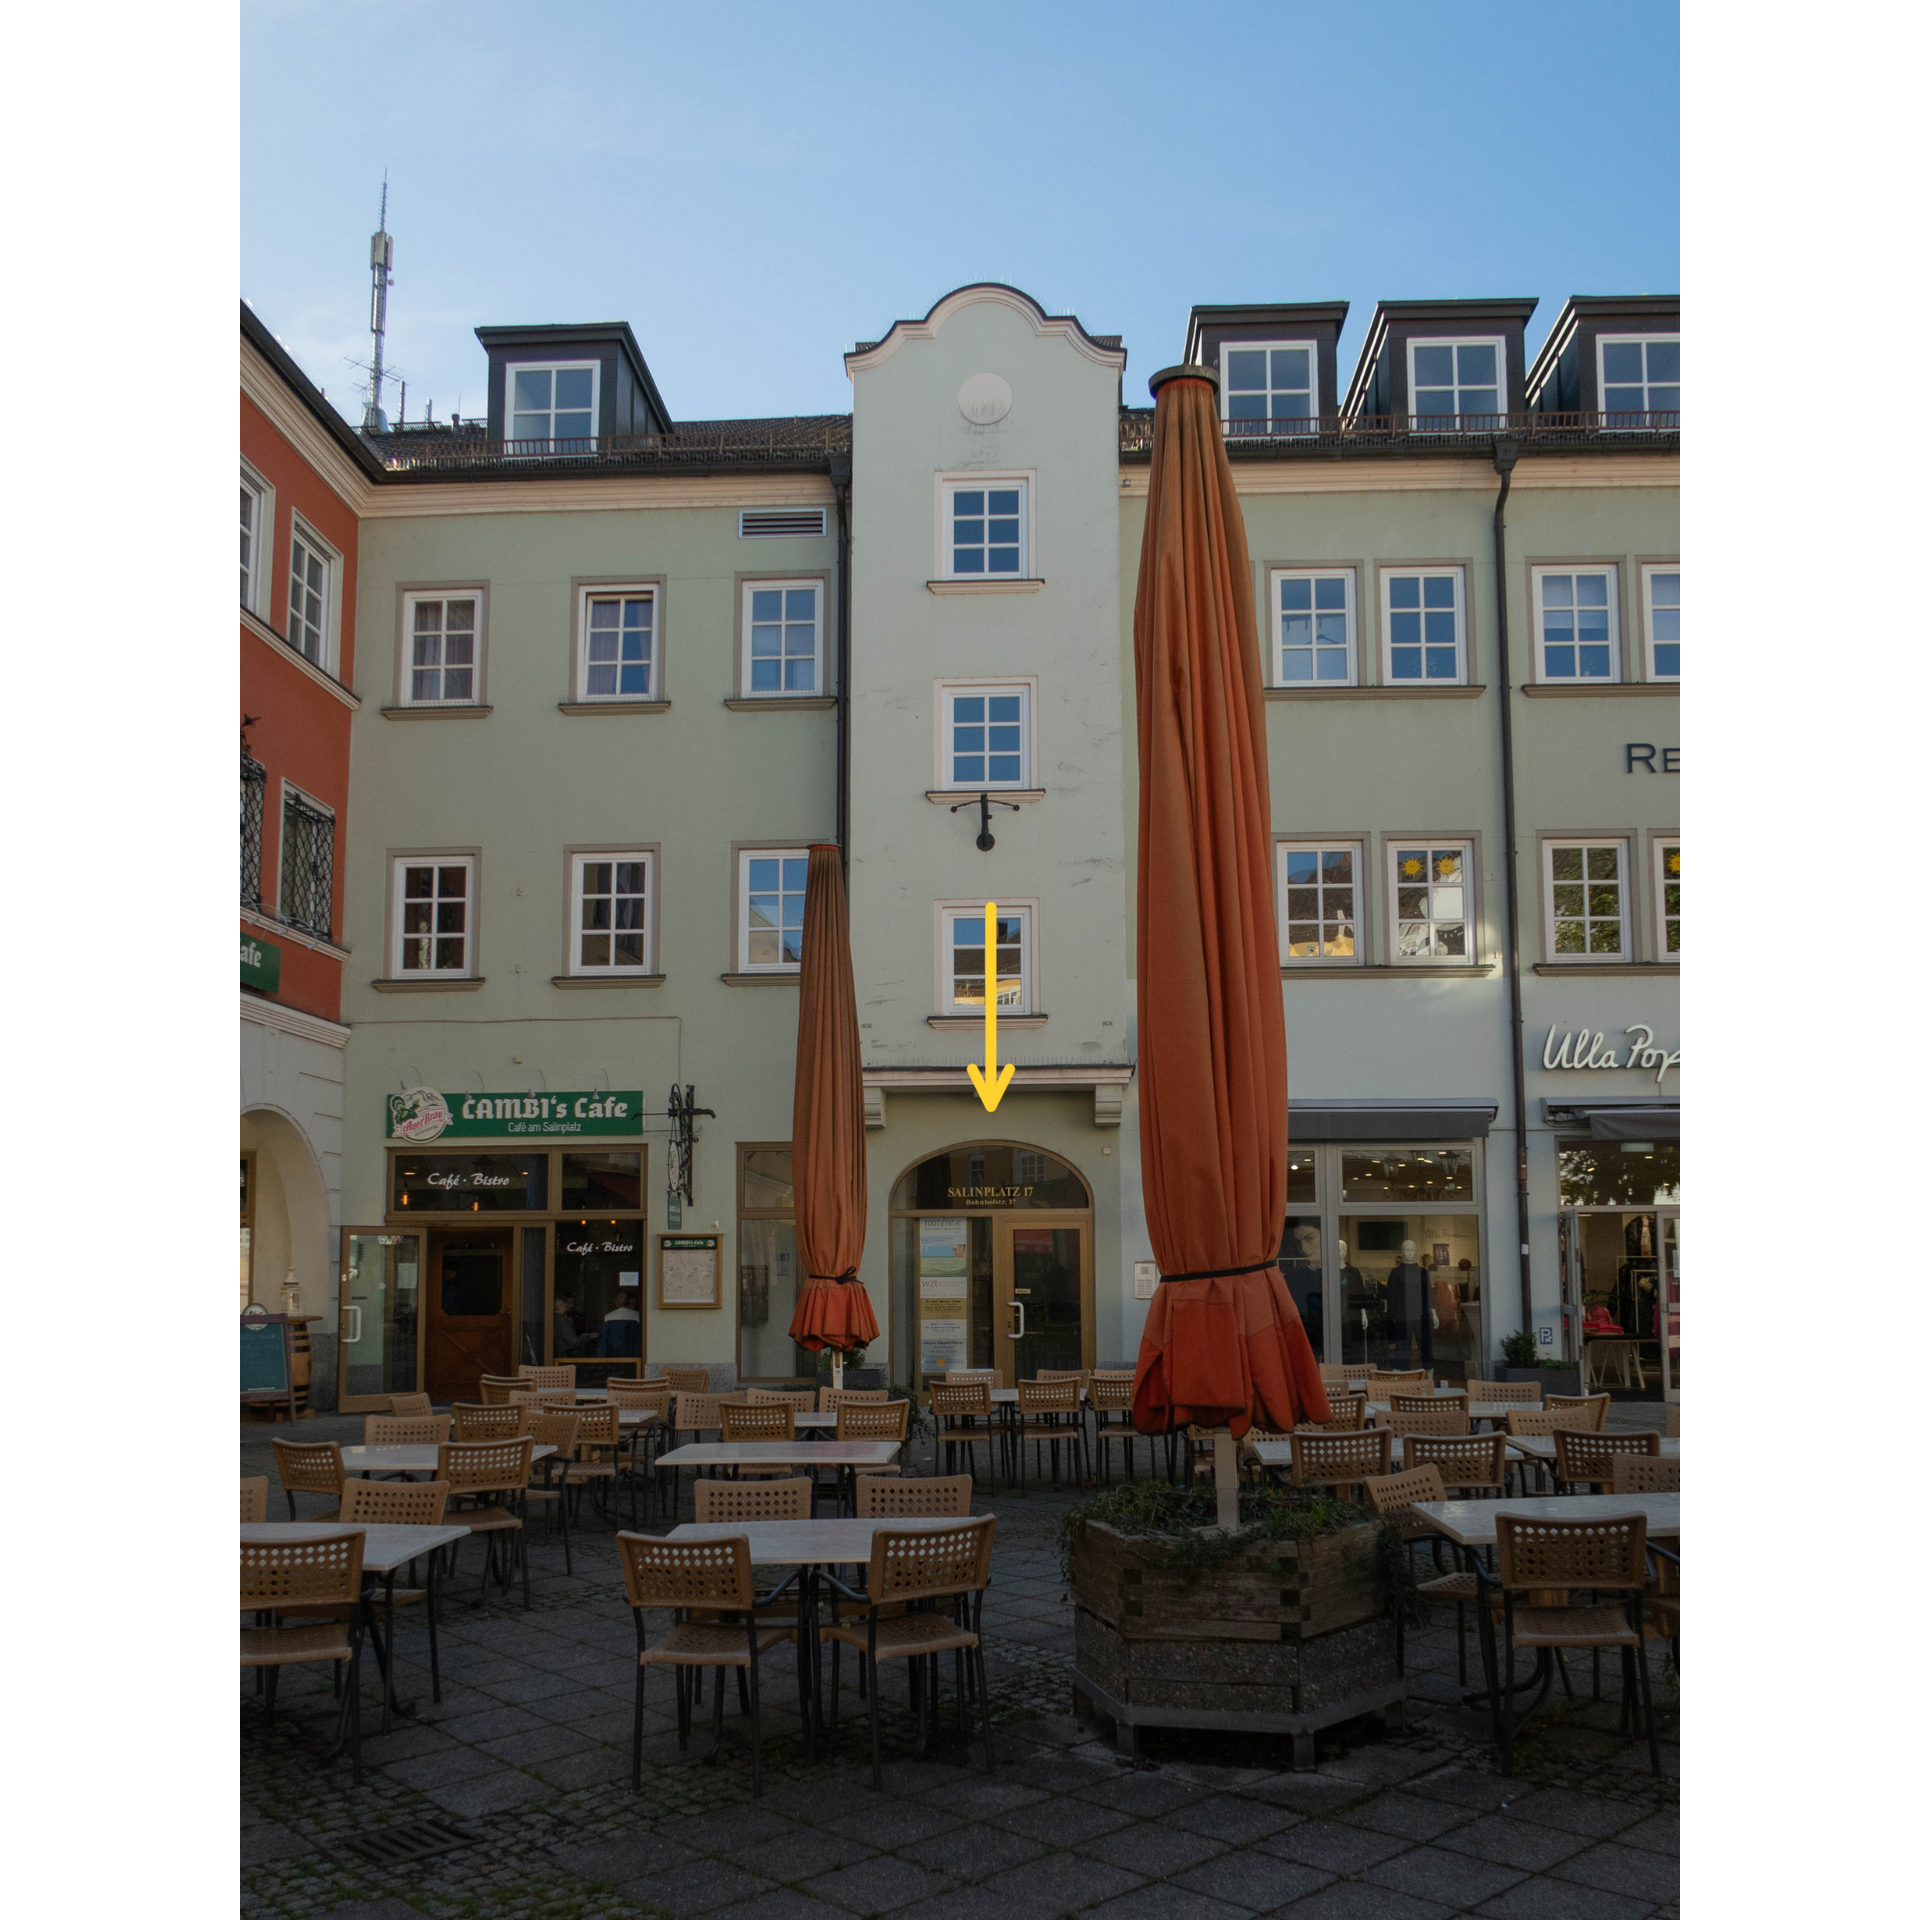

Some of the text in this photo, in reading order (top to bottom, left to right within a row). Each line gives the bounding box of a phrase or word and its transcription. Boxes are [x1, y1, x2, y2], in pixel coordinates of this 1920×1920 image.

[238, 941, 262, 968] afe
[1543, 1024, 1619, 1069] Ulla
[574, 1096, 628, 1119] Cafe
[508, 1121, 582, 1134] Café am Salinplatz
[427, 1172, 510, 1190] Café Bistro
[947, 1186, 1034, 1197] SALINPLATZ 17
[566, 1241, 634, 1256] Café Bistro
